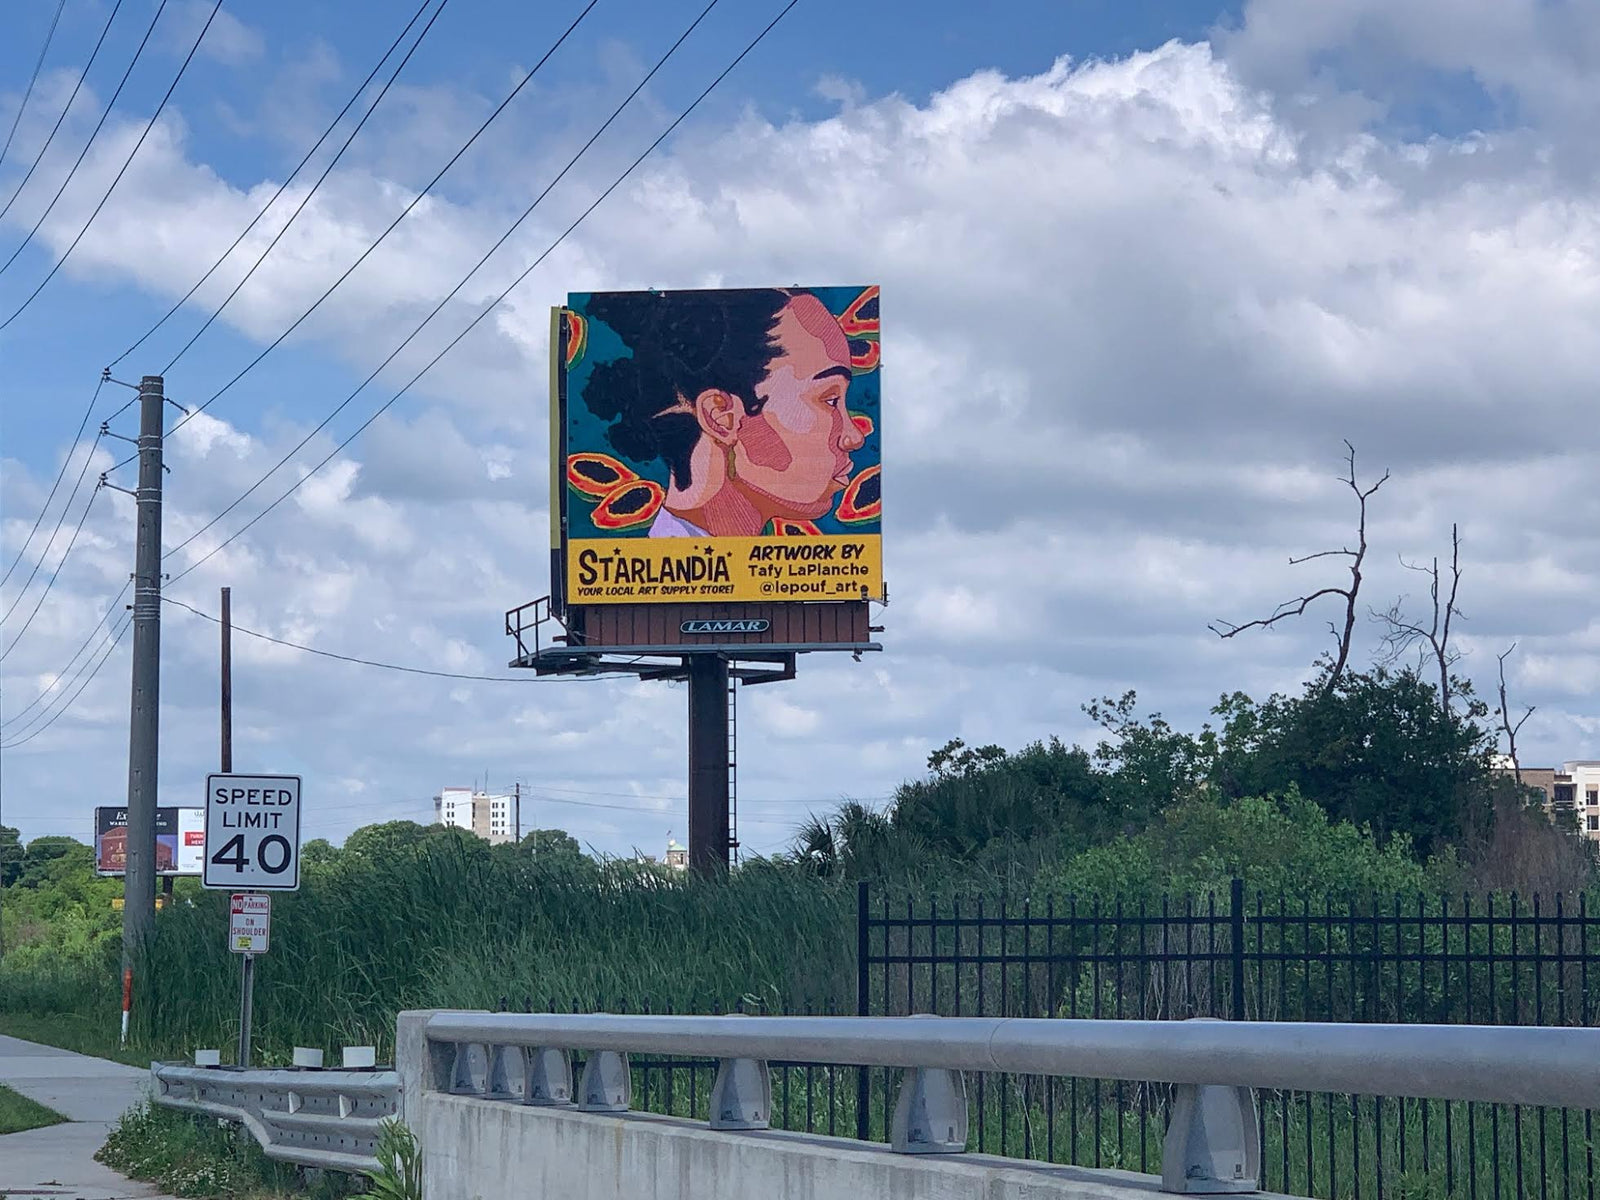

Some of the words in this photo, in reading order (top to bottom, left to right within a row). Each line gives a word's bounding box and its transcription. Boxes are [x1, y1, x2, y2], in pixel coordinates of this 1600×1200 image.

[749, 545, 836, 560] ARTWORK
[841, 544, 865, 559] BY
[579, 549, 730, 585] STARLANDIA
[748, 564, 782, 578] Tafy
[788, 563, 869, 576] LaPlanche
[577, 587, 602, 596] YOUR
[605, 587, 635, 595] LOCAL
[638, 586, 658, 595] ART
[660, 585, 697, 595] SUPPLY
[700, 584, 735, 594] STORE!
[760, 580, 857, 595] @lepouf_art
[688, 621, 761, 631] LAMAR
[215, 788, 292, 806] SPEED
[223, 811, 283, 829] LIMIT
[211, 834, 292, 874] 40
[232, 899, 243, 910] NO
[244, 901, 268, 909] PARKING
[245, 918, 254, 926] ON
[232, 927, 267, 936] SHOULDER
